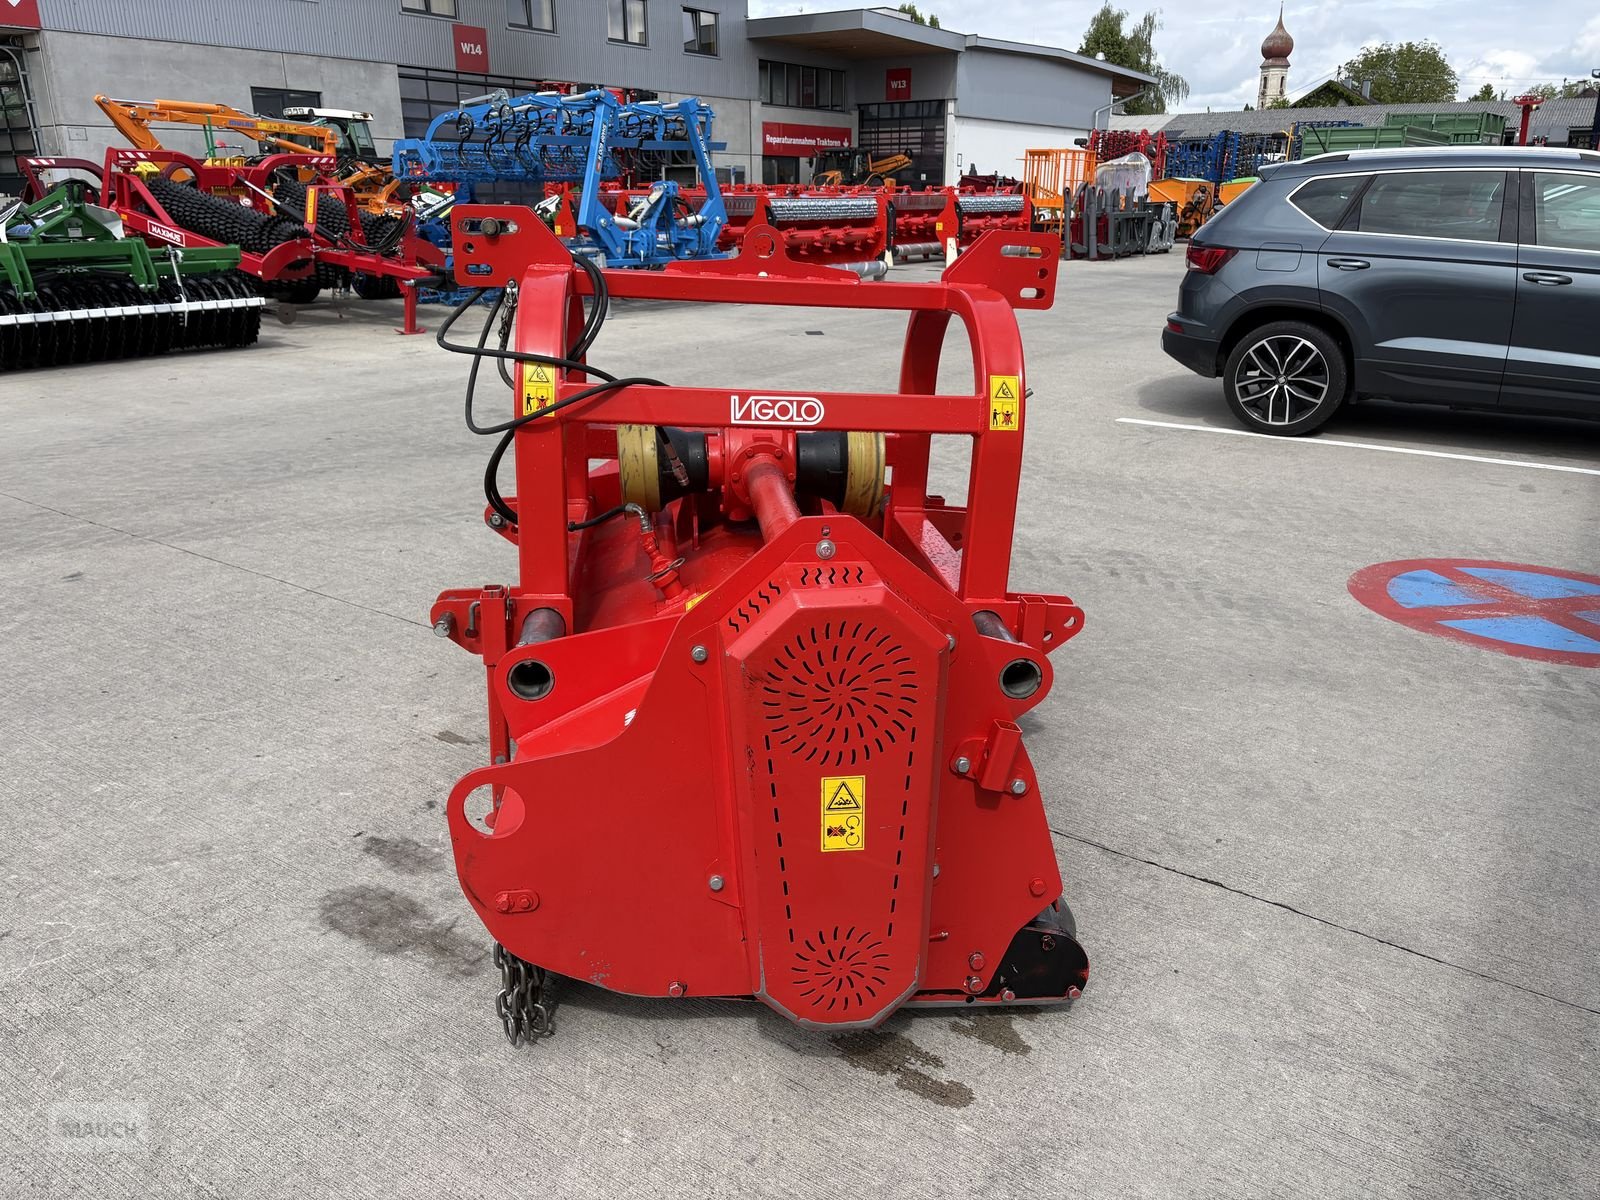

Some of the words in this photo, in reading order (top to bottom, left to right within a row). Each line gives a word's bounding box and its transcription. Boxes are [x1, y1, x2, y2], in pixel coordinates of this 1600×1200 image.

[460, 42, 483, 56] W14
[890, 80, 906, 89] W13
[765, 134, 816, 146] Reparaturannahme
[816, 137, 841, 147] Traktoren
[730, 395, 825, 426] VIGOLO
